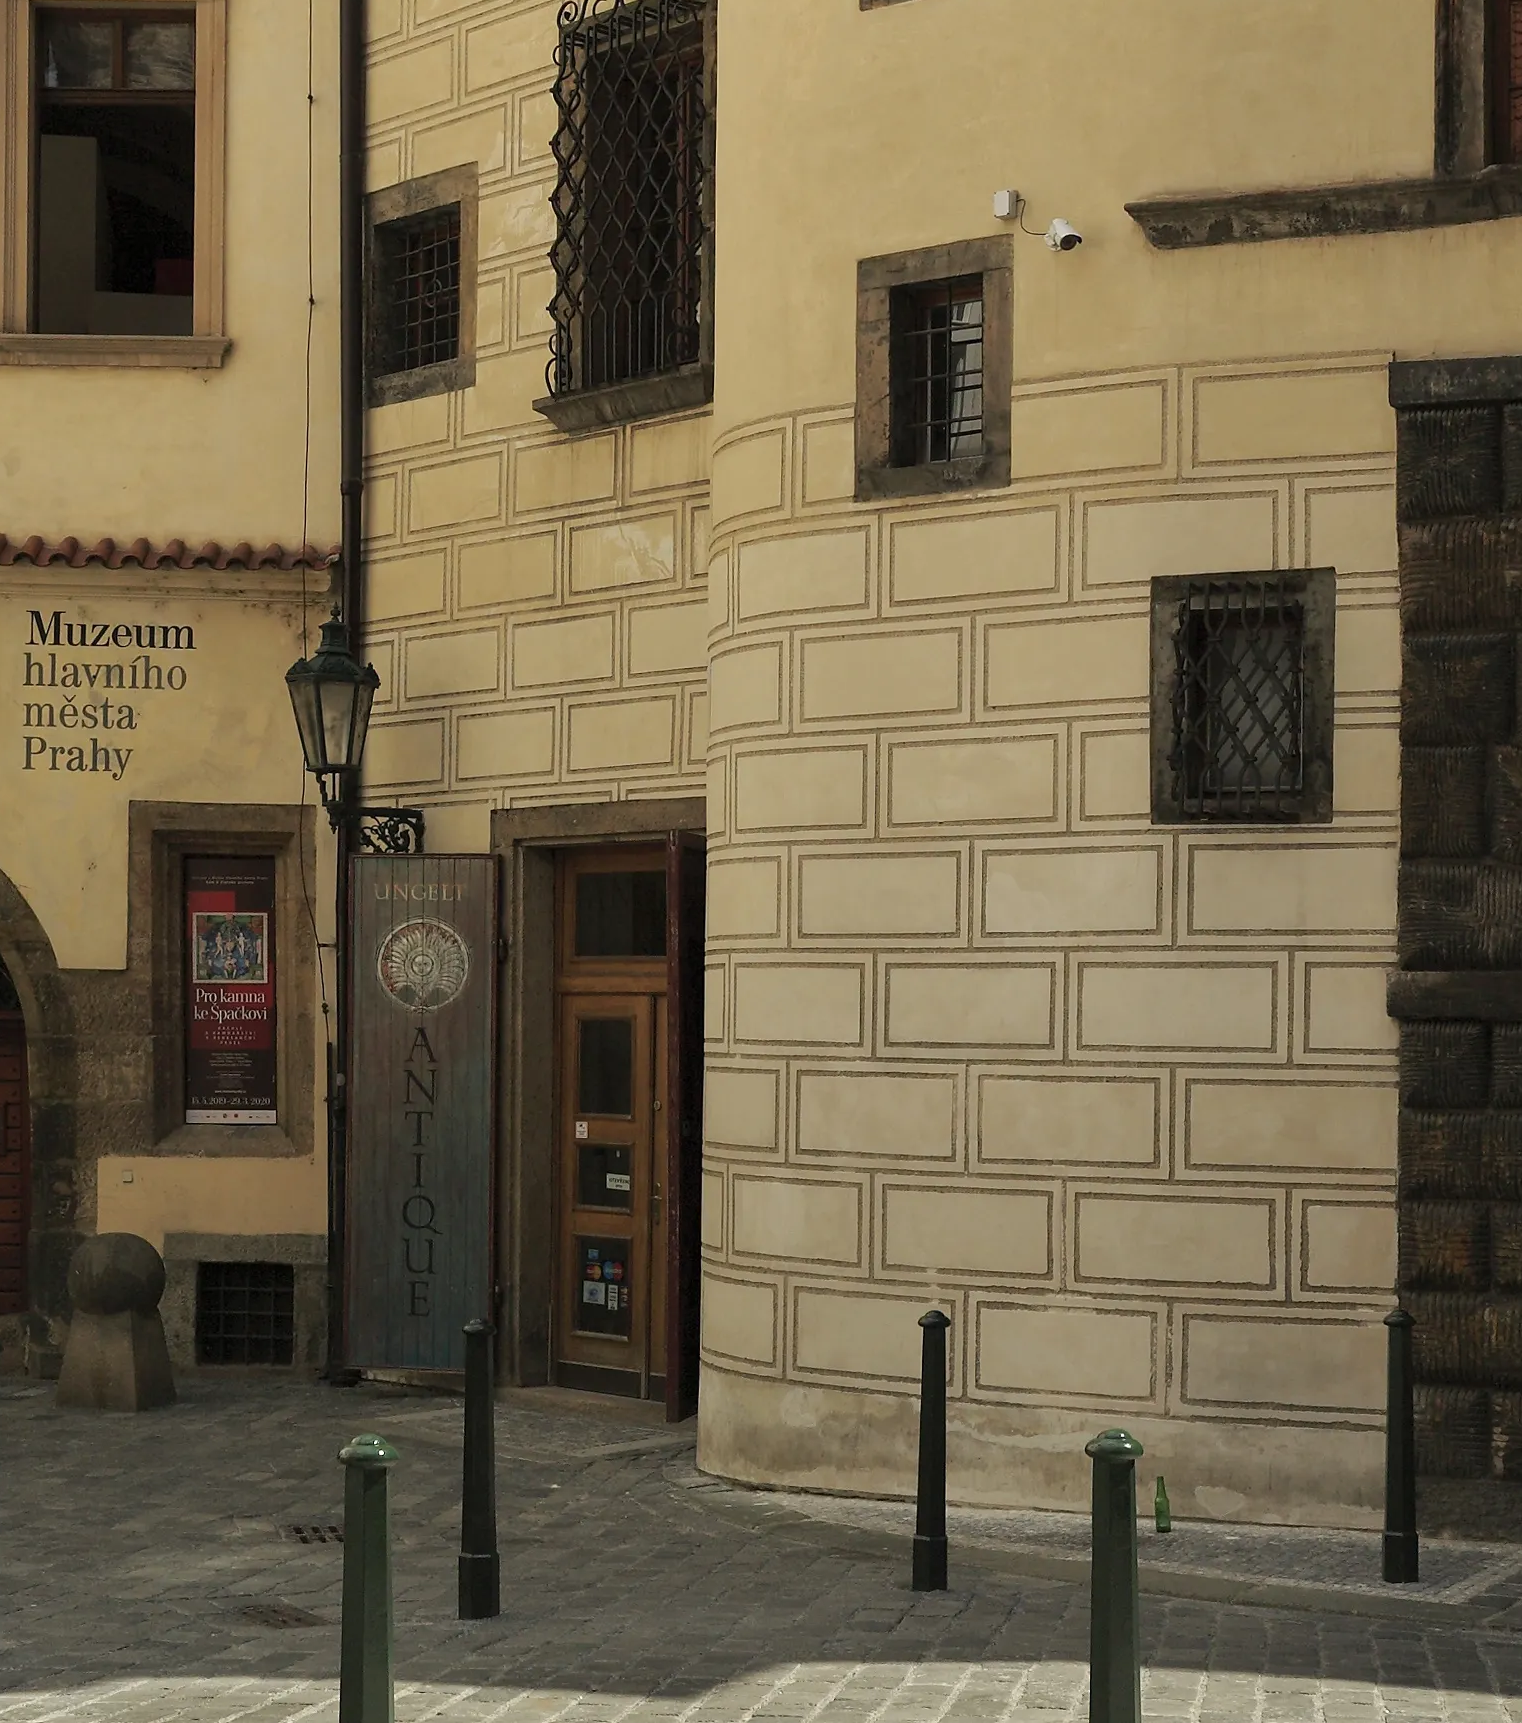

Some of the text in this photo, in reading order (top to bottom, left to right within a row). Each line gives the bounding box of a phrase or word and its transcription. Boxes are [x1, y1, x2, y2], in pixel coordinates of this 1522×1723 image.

[25, 609, 197, 650] Muzeum
[22, 652, 187, 690] hlavního
[22, 694, 138, 730] města
[22, 736, 134, 781] Prahy
[373, 883, 467, 902] UNGELT
[194, 1003, 268, 1024] ke Špačkovi
[195, 988, 266, 1003] Pro kamna
[402, 1026, 445, 1318] ANTIQUE
